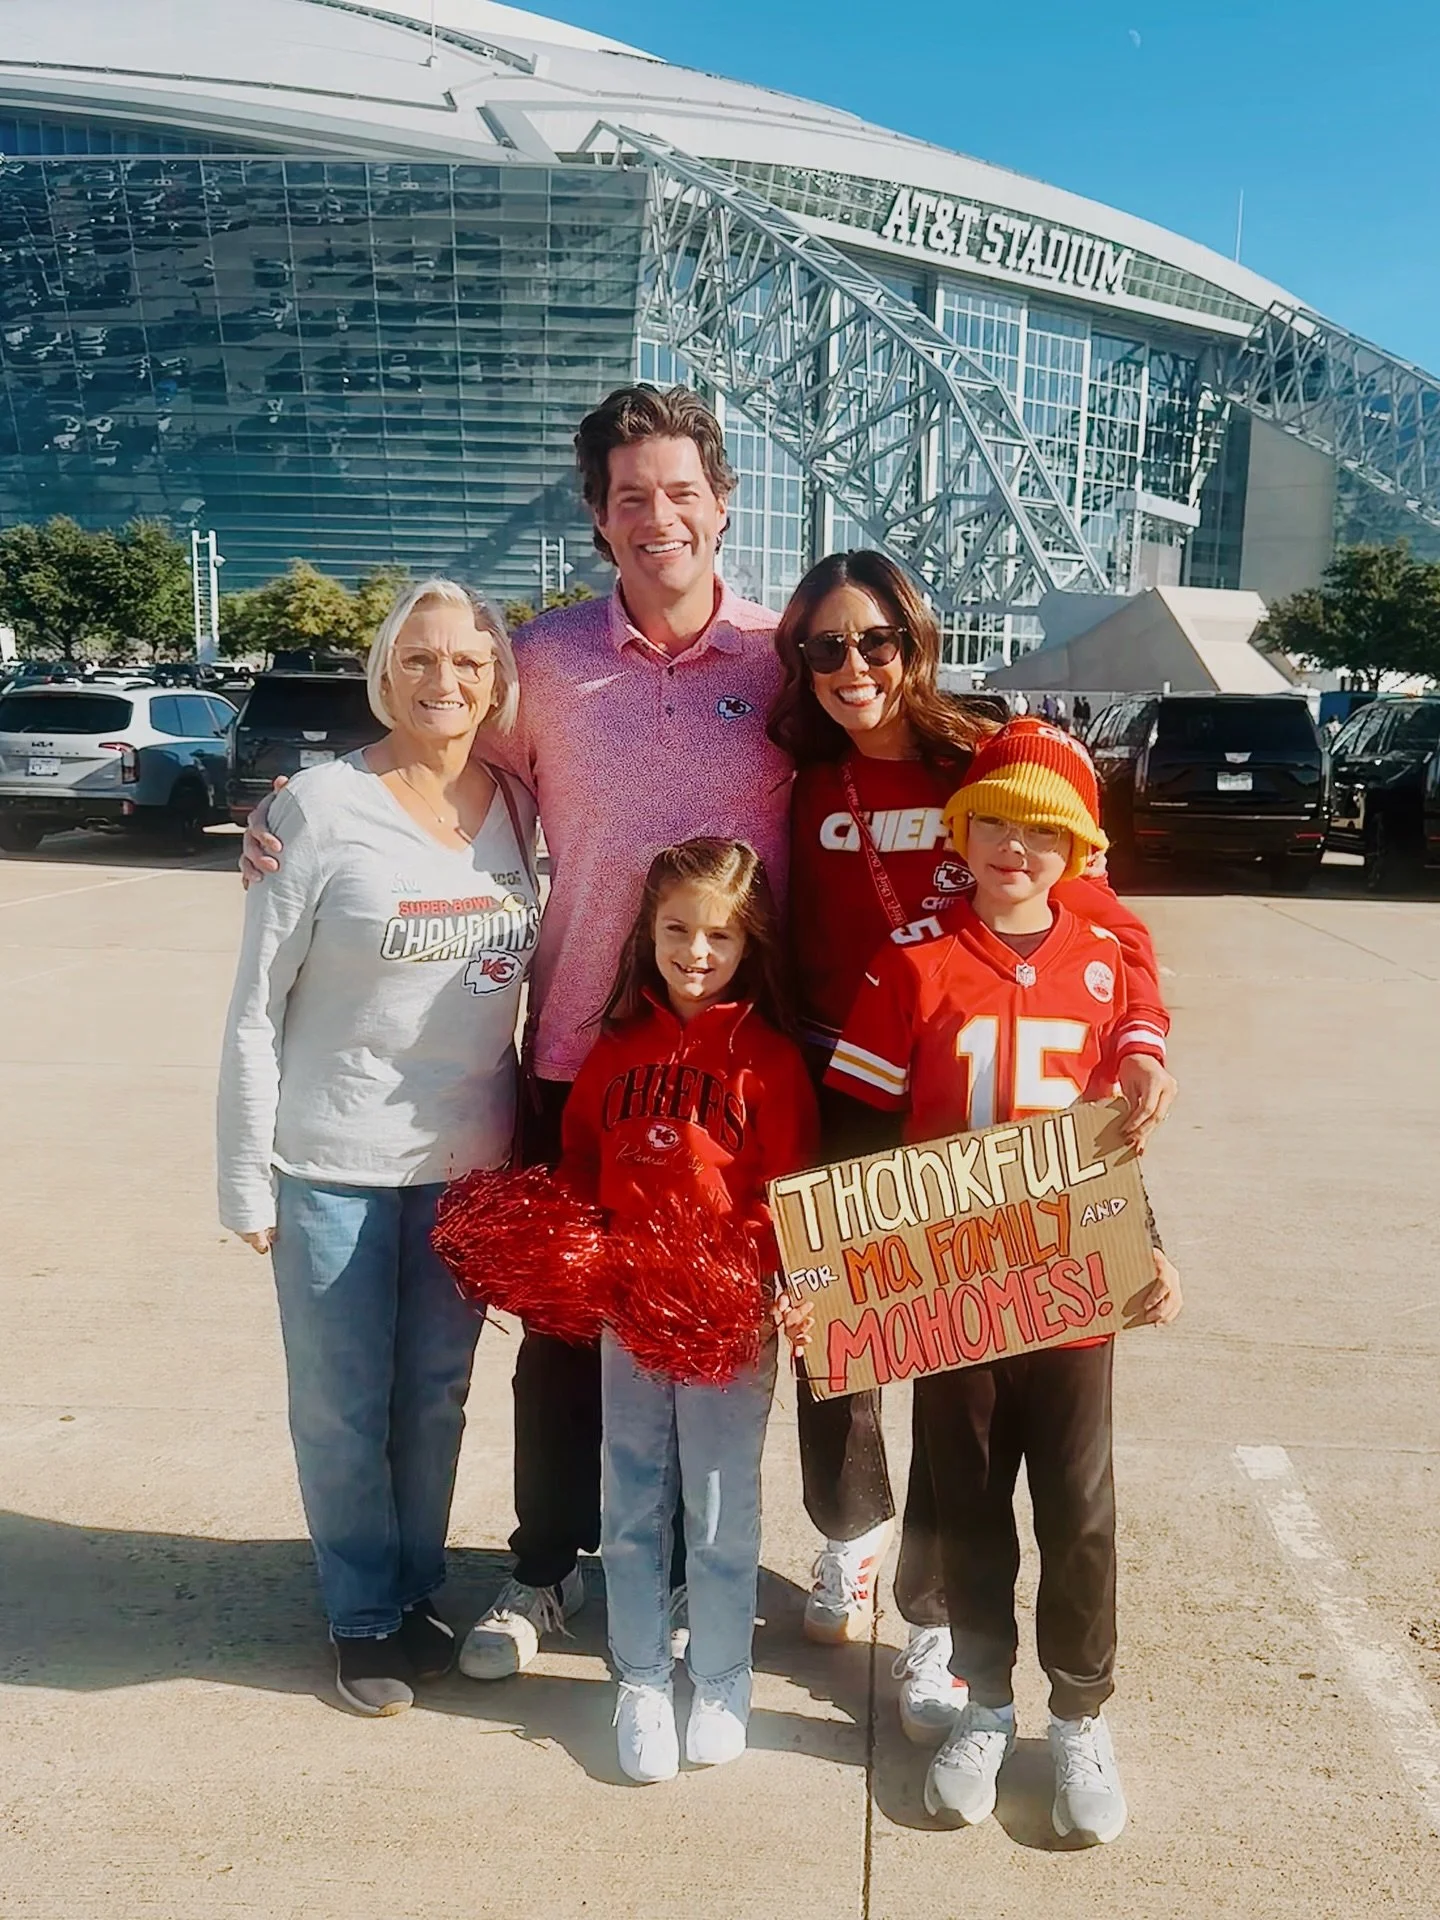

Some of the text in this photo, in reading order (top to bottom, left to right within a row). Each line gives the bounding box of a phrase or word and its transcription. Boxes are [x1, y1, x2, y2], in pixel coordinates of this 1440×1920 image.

[881, 188, 1136, 296] AT&T STADIUM
[819, 807, 953, 853] CHIEF
[381, 902, 540, 961] CHAMPIONS
[400, 896, 495, 916] SUPER BOWL
[602, 1063, 746, 1154] CHIEFS
[956, 1015, 1091, 1129] 15
[789, 1264, 839, 1300] FOR
[1080, 1197, 1128, 1227] AND
